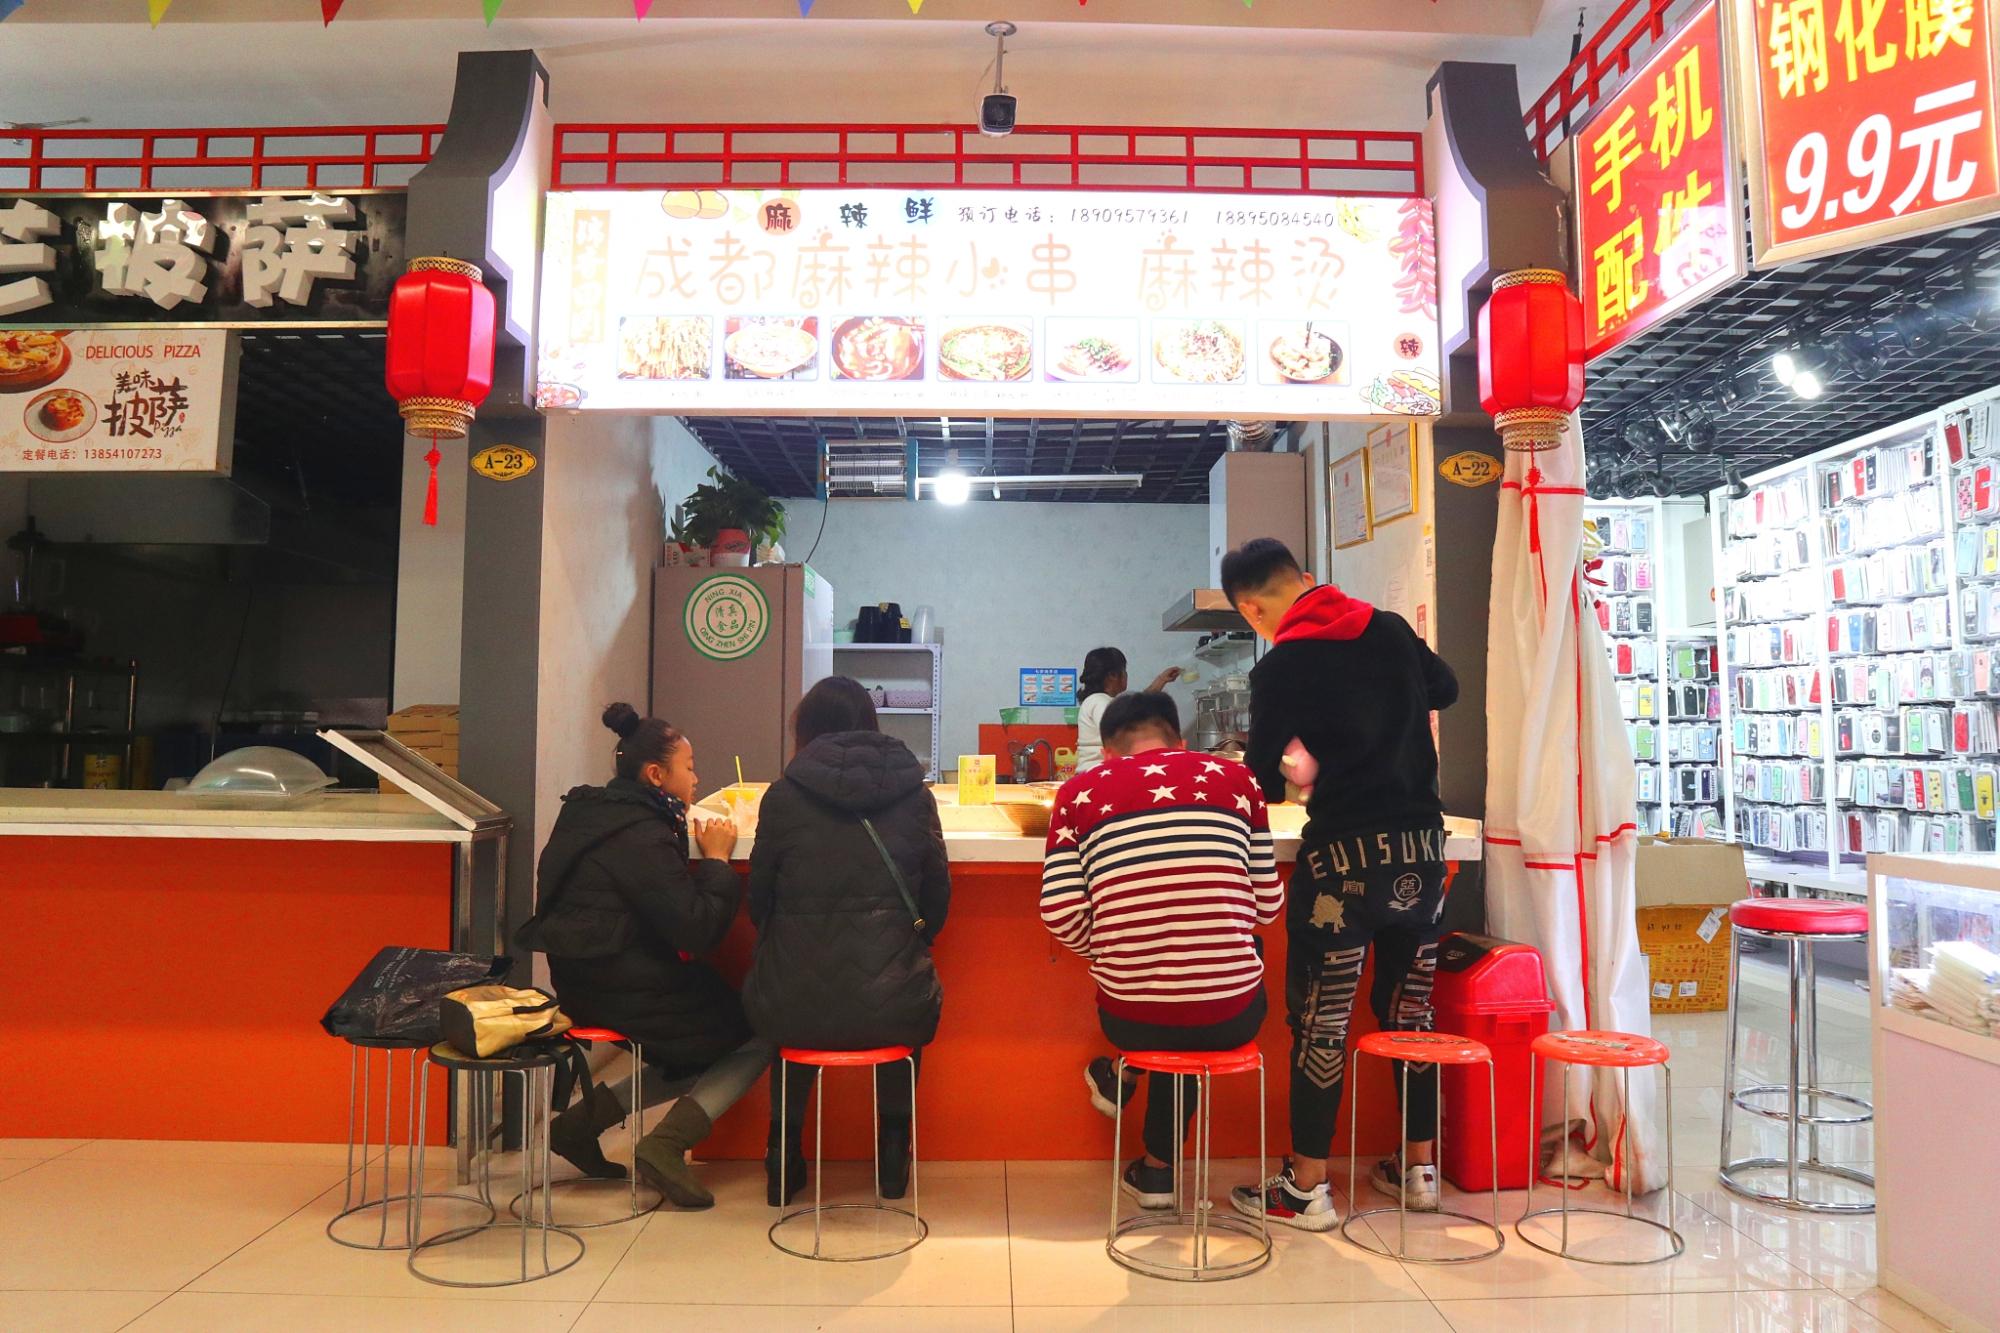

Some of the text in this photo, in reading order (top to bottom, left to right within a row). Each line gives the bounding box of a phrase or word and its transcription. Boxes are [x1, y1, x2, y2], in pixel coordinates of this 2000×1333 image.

[1766, 0, 1974, 99] 钢化膜
[1591, 45, 1713, 213] 手机
[1780, 80, 1983, 230] 9.9元
[765, 197, 934, 231] 麻 辣 鲜
[1595, 171, 1713, 331] 配件
[635, 228, 1077, 309] 成都麻辣小串
[1138, 230, 1345, 311] 麻辣烫
[85, 345, 201, 360] DELICIOUS PIZZA
[115, 368, 156, 394] 美味
[101, 376, 189, 438] 披萨
[84, 448, 162, 460] 13854107273
[484, 453, 523, 469] A-23
[1453, 461, 1490, 476] A-22
[704, 588, 743, 603] NING XIA
[699, 627, 715, 644] QING
[715, 639, 736, 649] ZHEN
